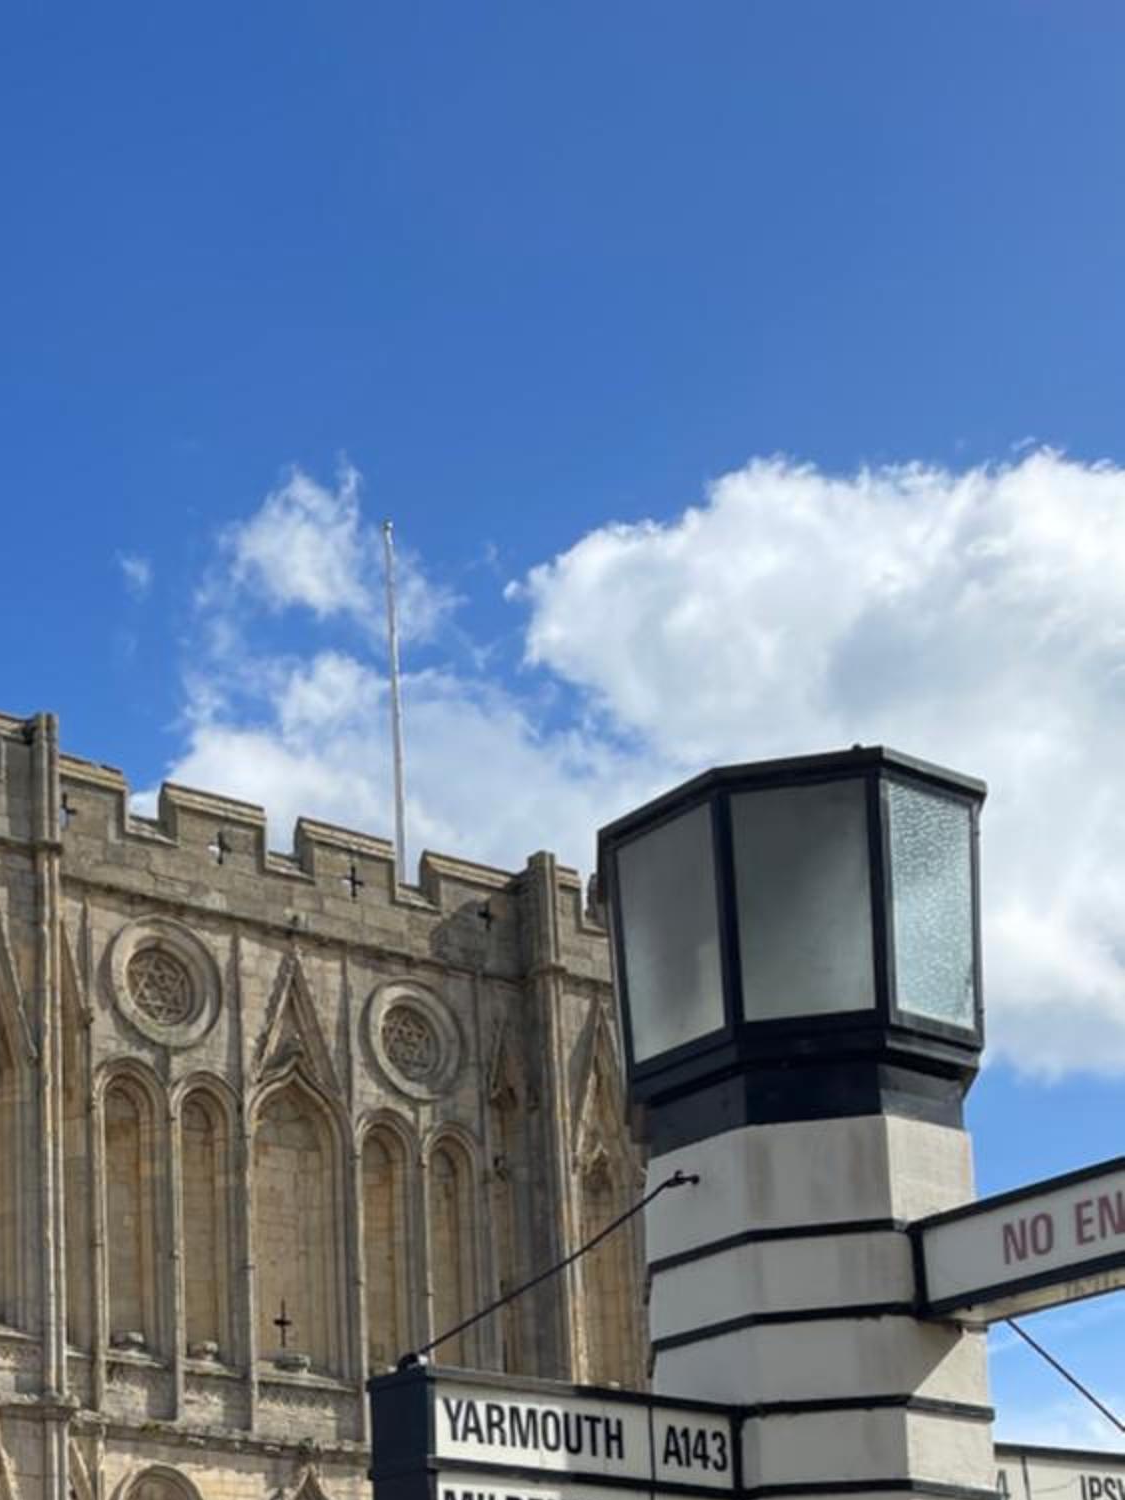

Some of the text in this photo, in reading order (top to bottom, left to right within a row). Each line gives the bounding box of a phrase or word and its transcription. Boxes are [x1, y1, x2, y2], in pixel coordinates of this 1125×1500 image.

[1003, 1191, 1125, 1264] NO EN
[444, 1398, 728, 1472] YARMOUTH A143
